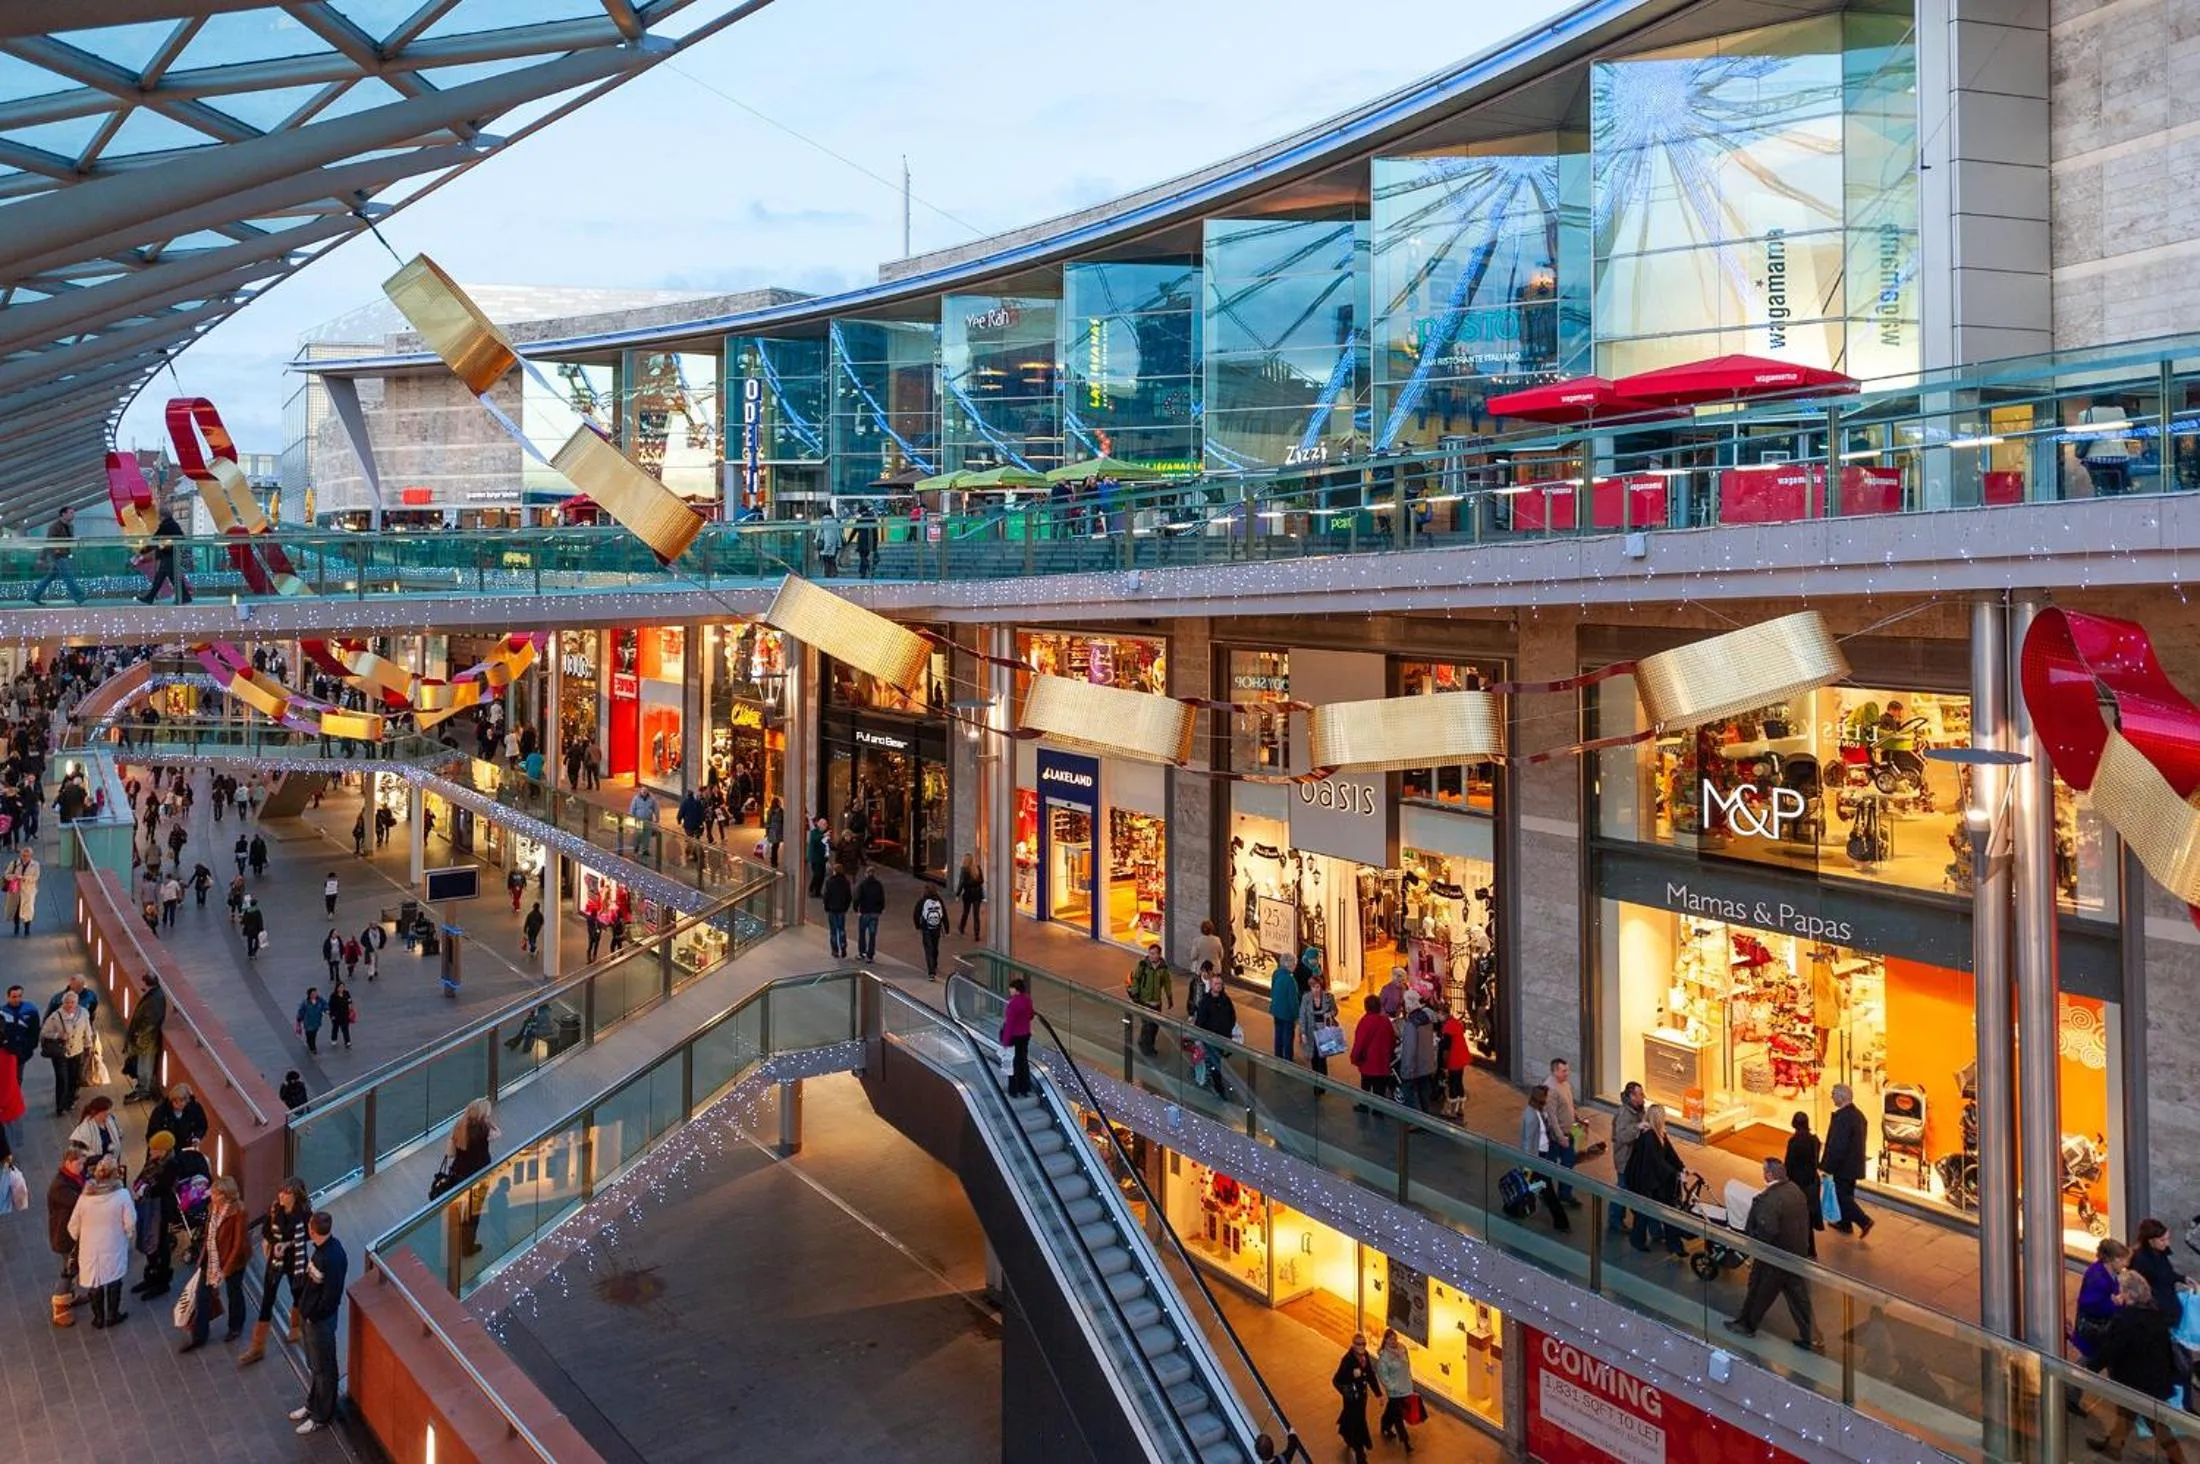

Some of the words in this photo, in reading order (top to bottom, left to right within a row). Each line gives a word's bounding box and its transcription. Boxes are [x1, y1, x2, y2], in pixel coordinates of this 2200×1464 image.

[987, 308, 1009, 328] Rah
[1768, 228, 1790, 349] wagamama
[1285, 441, 1328, 466] Zizzi
[1050, 768, 1092, 787] LAKELAND
[1299, 779, 1376, 817] oasis
[1703, 778, 1805, 840] M&P
[1666, 881, 1747, 920] Mamas
[1754, 902, 1773, 926] &
[1779, 903, 1852, 941] Papas
[1542, 1336, 1663, 1419] COMING
[1545, 1374, 1580, 1401] 1,831
[1619, 1412, 1634, 1430] TO
[1639, 1422, 1660, 1443] LET
